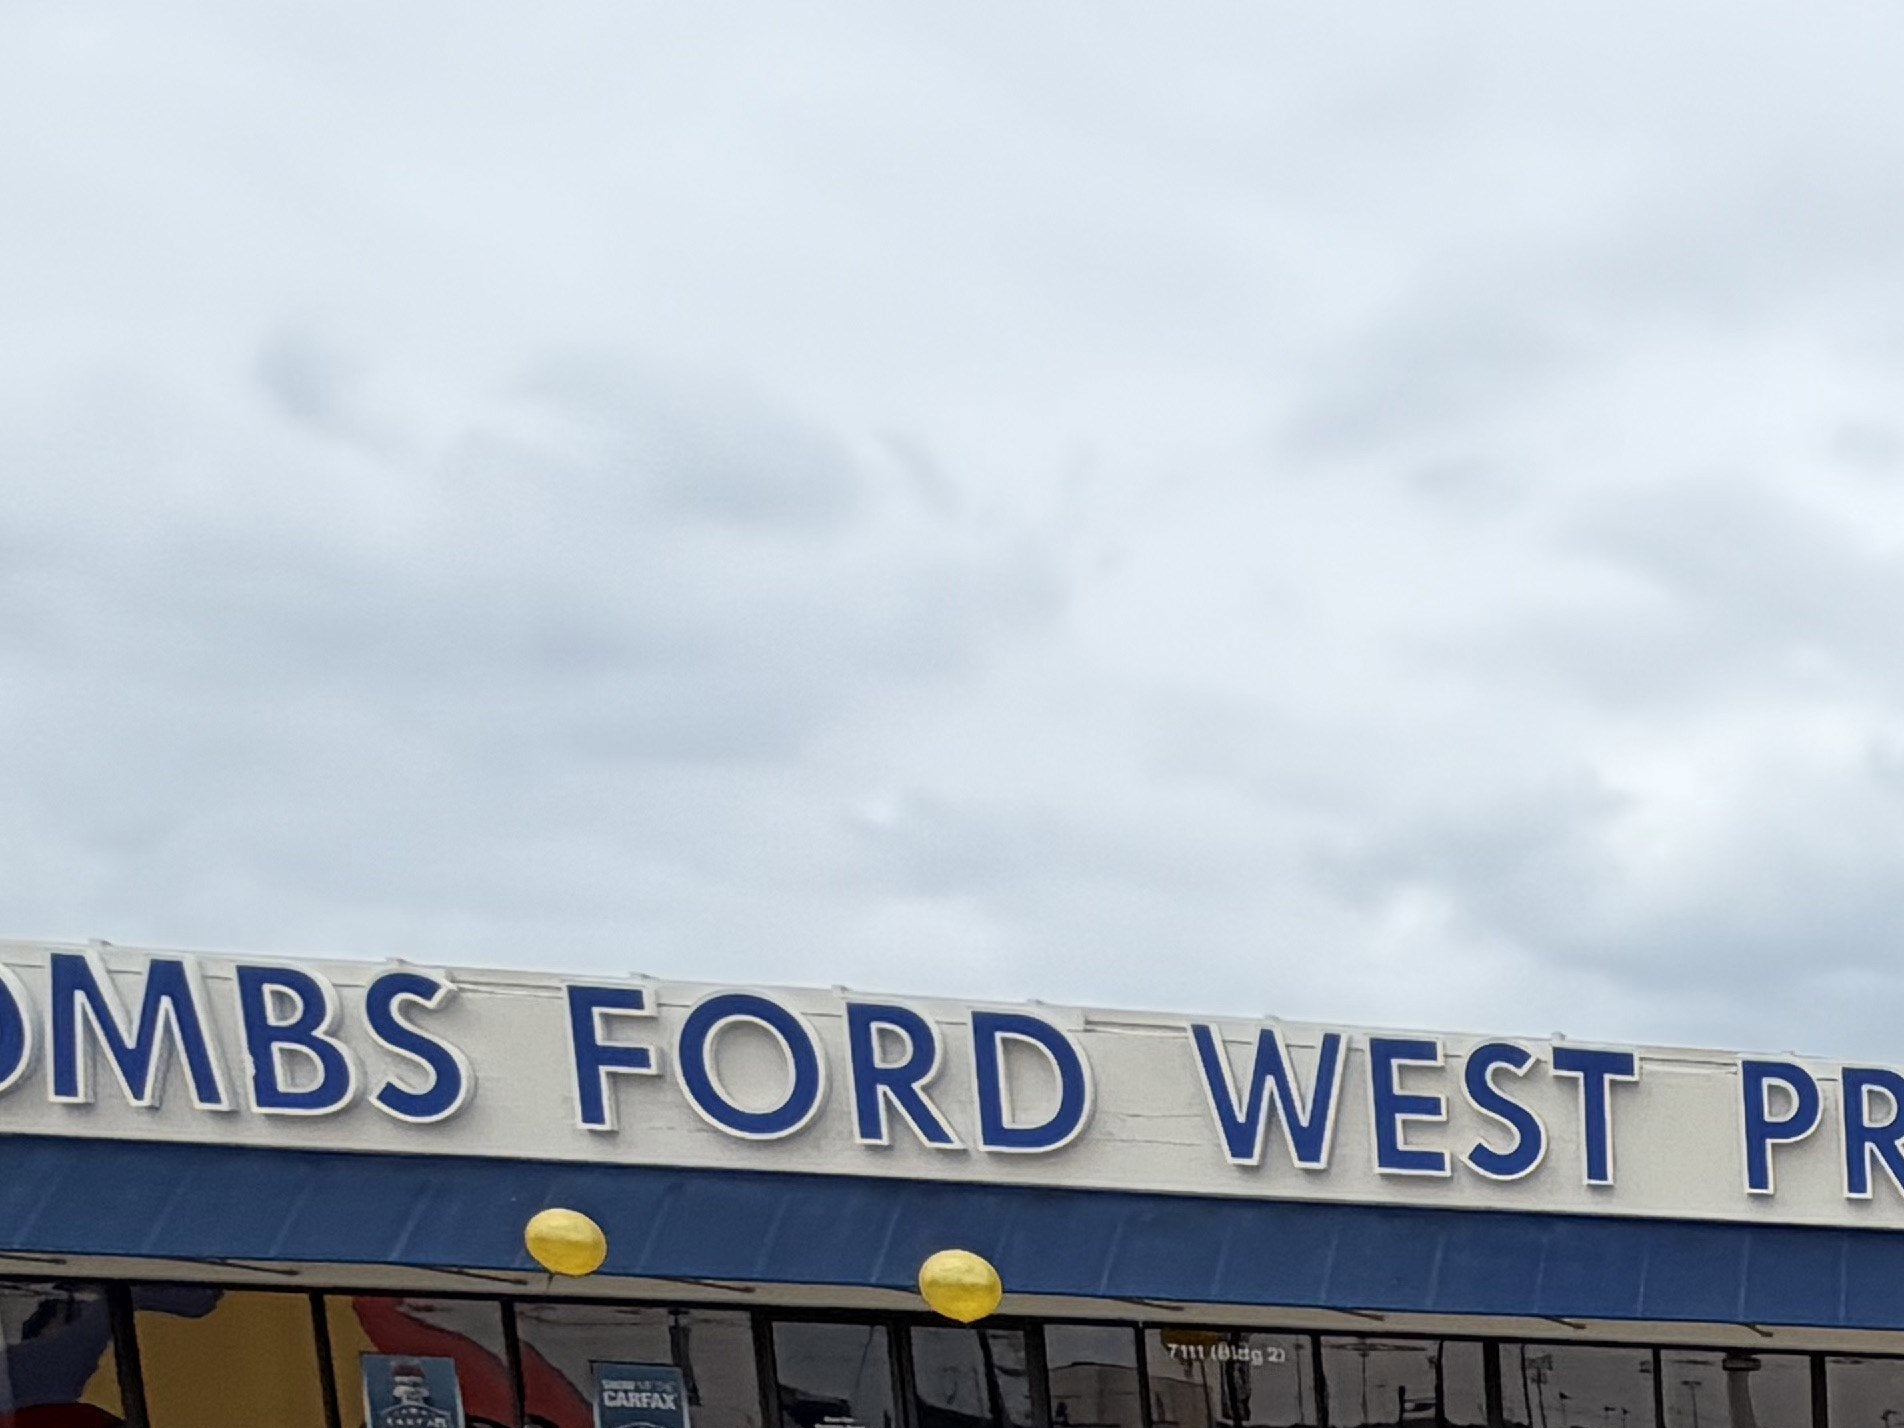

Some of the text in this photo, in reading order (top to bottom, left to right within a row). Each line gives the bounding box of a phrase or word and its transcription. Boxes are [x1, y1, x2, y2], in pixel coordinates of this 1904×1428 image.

[0, 950, 472, 1124] MBS
[566, 984, 1094, 1154] FORD
[1187, 1022, 1640, 1188] WEST
[602, 1391, 677, 1410] CARFAX
